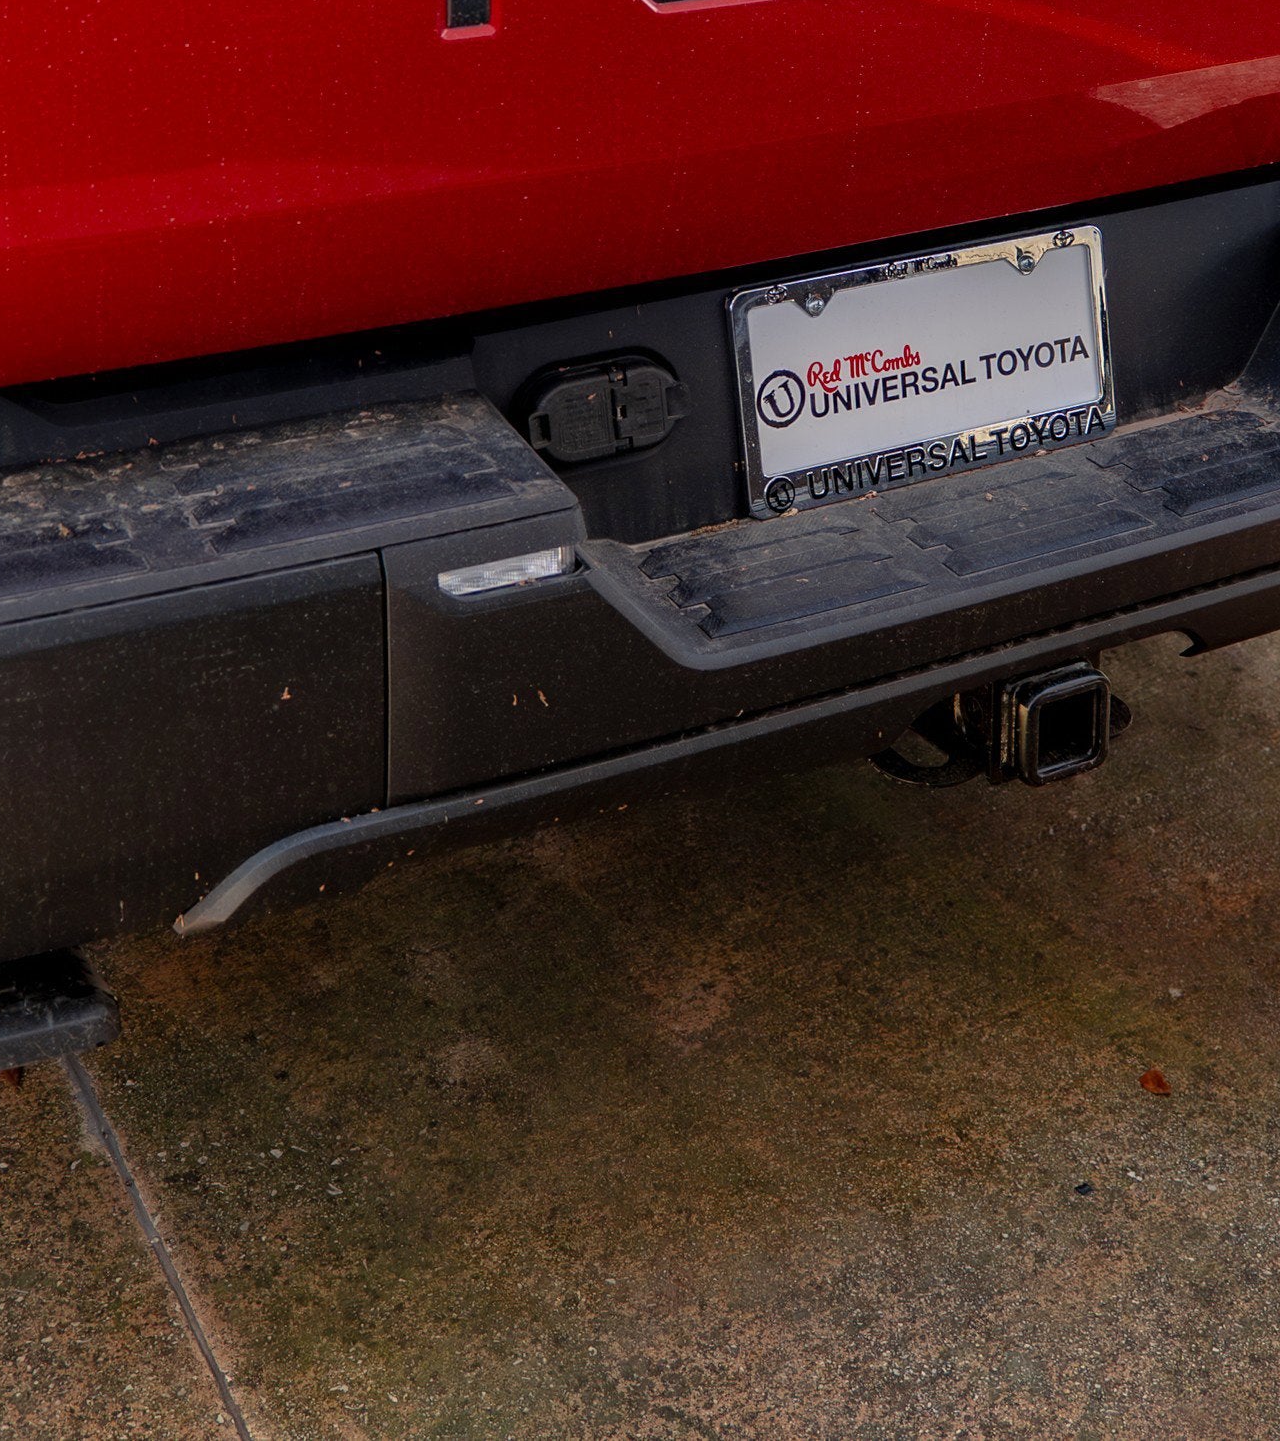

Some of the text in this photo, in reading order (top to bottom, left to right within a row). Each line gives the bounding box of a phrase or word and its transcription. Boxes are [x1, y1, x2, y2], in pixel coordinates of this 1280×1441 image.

[807, 344, 921, 393] Red McCombs
[809, 335, 1090, 418] UNIVERSAL TOYOTA
[806, 405, 1106, 500] UNIVERSAL TOYOTA
